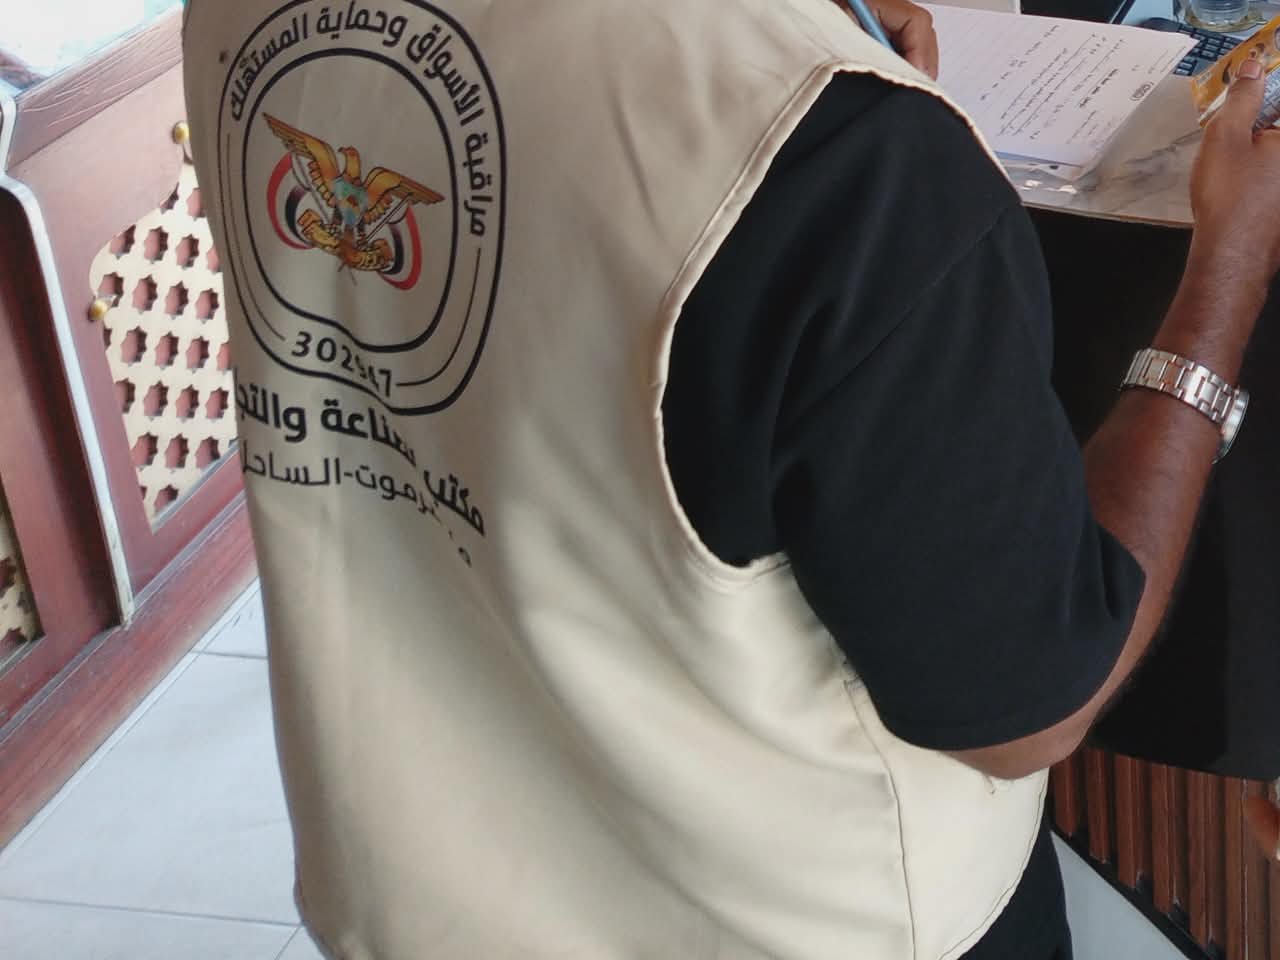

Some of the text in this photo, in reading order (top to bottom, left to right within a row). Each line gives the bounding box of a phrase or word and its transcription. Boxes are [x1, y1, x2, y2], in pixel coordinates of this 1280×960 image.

[229, 0, 494, 238] مراقبة الأسواق وحماية المستهلك
[423, 469, 485, 537] مكتب
